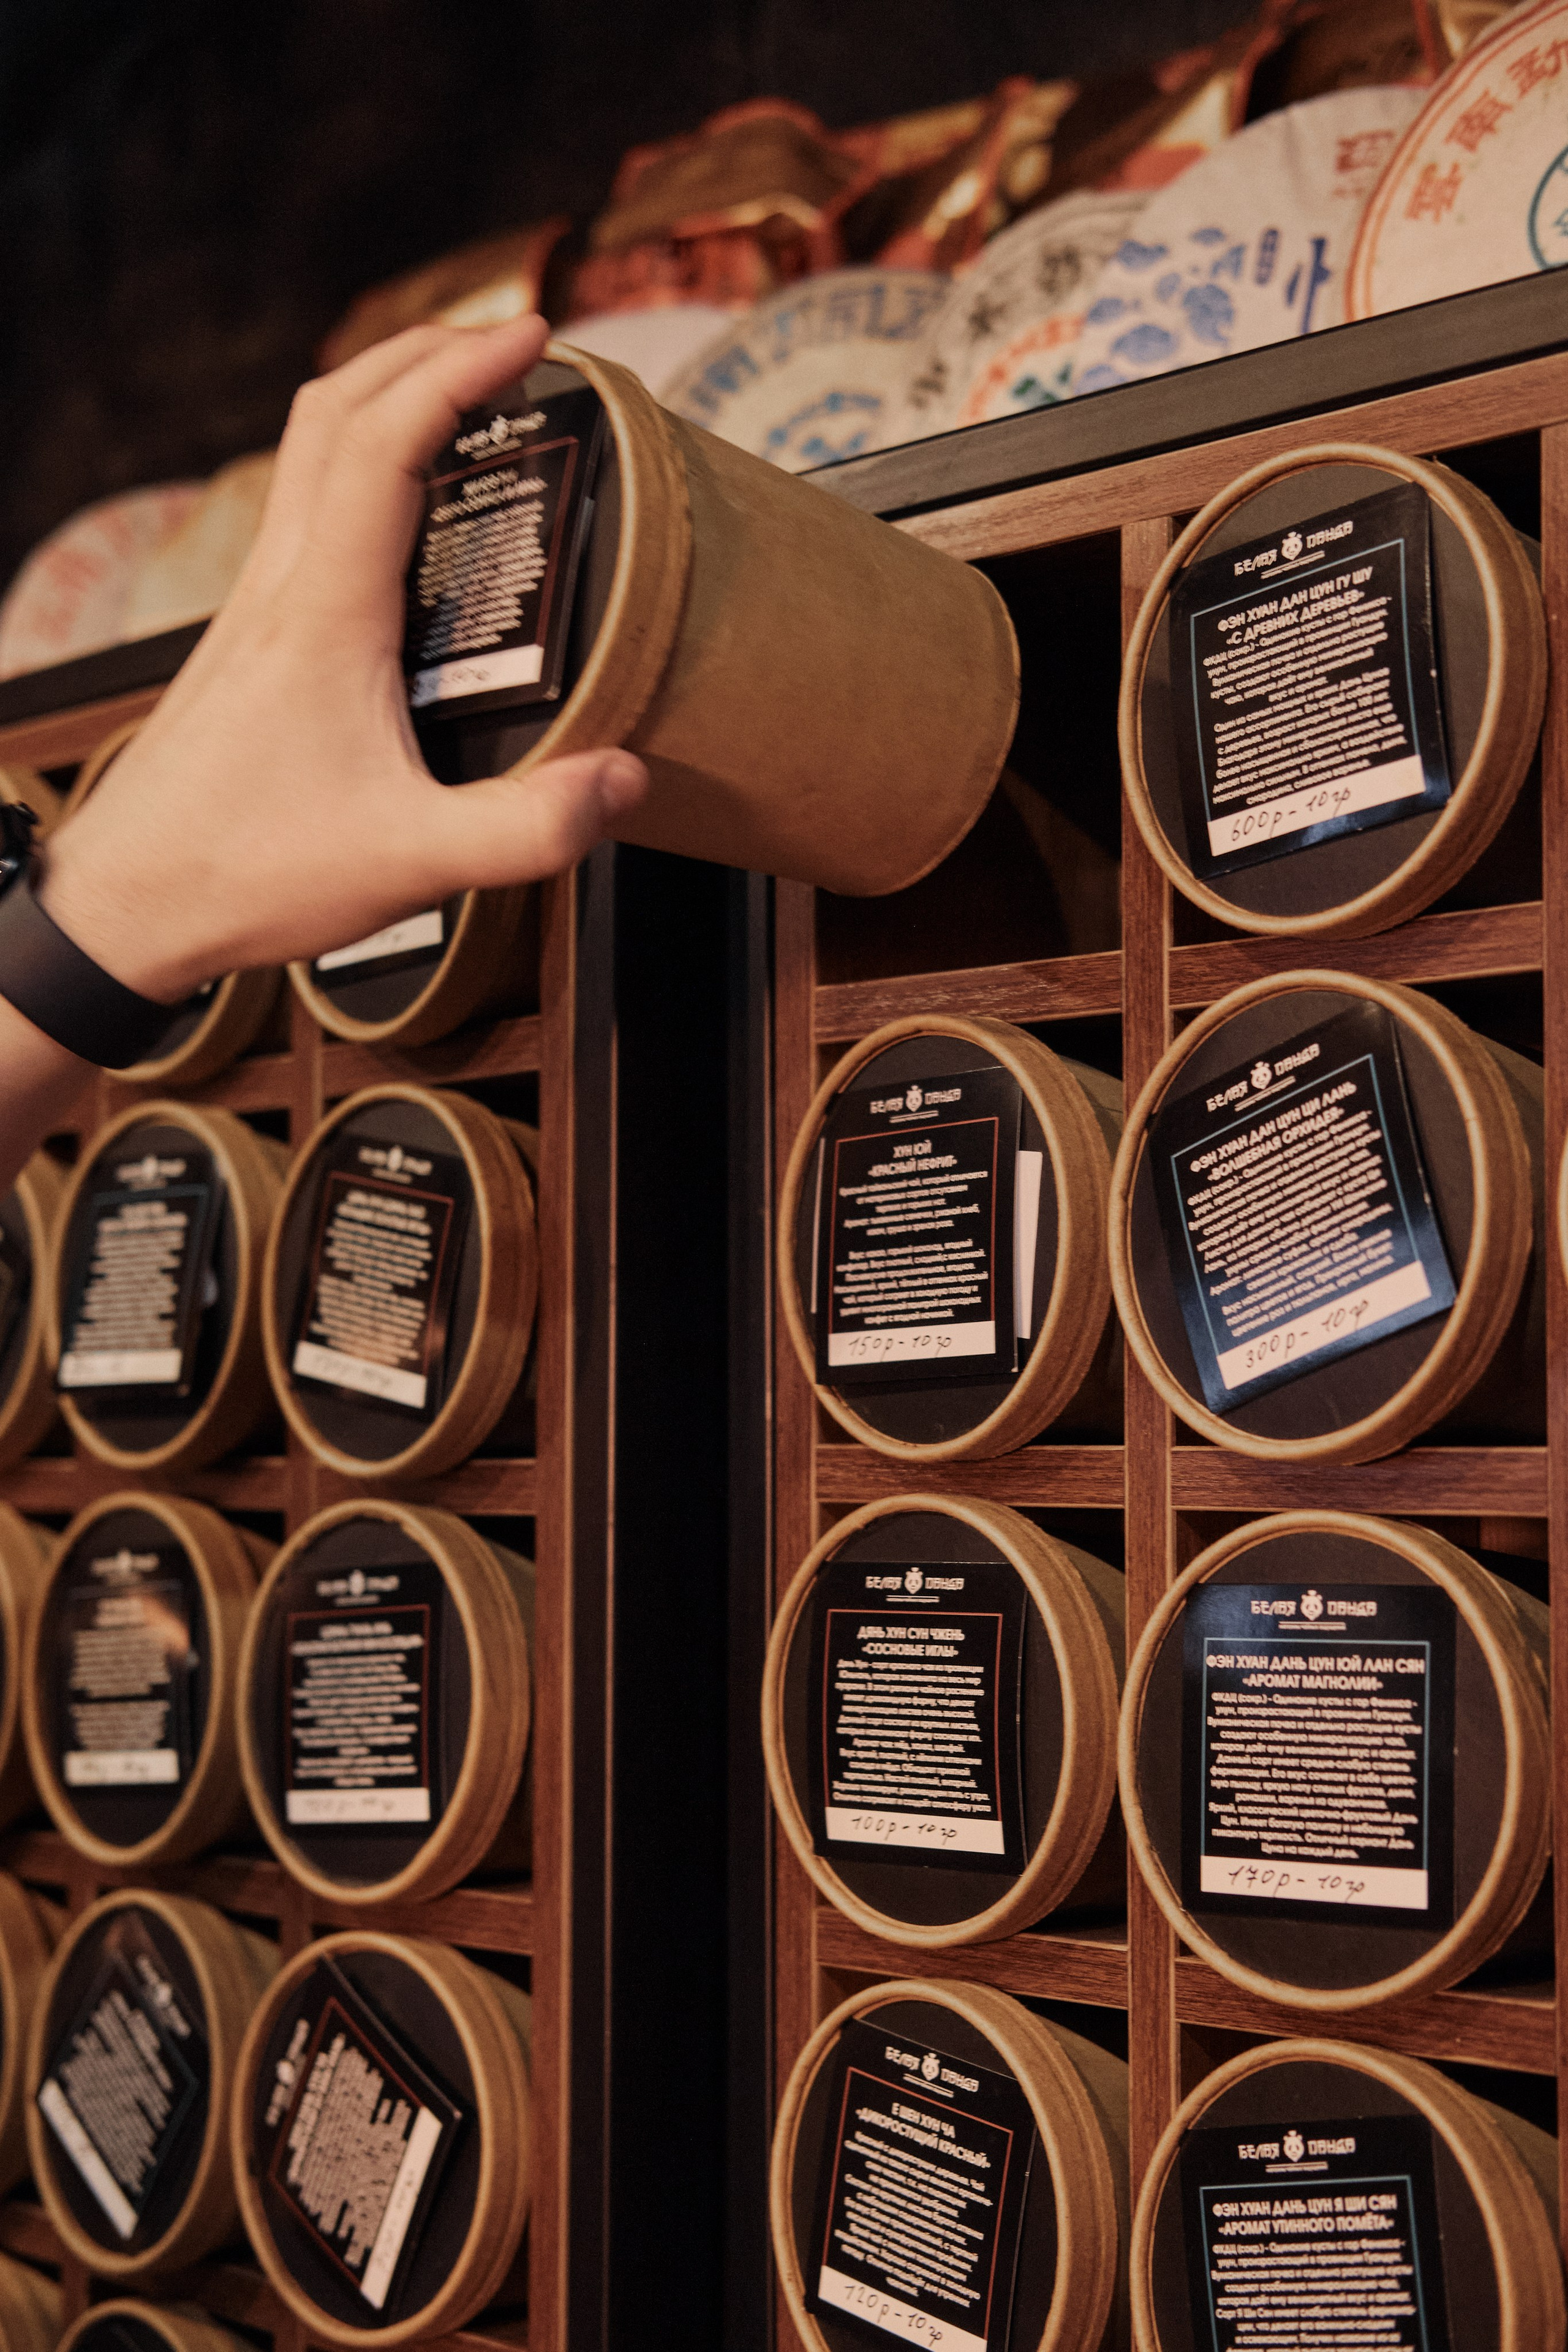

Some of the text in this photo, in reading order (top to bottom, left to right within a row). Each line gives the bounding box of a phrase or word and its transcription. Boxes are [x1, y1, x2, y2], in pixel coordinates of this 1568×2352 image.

[1234, 549, 1278, 576] БЕЛАЯ
[1306, 521, 1353, 548] ПАНДА
[1218, 566, 1373, 631] ФЭН ХУАН ДАН ЦУН ГУ ШУ
[1243, 610, 1299, 643] ДРЕВНИХ
[1206, 1080, 1248, 1112] БЕЛАЯ
[1274, 1044, 1320, 1076] ПАНДА
[870, 1088, 961, 1114] БЕЛАЯ ПАНДА
[1190, 1151, 1218, 1172] ФЭН
[1216, 1135, 1248, 1160] ХУАН
[1249, 1120, 1276, 1145] ДАН
[1276, 1107, 1302, 1129] ЦУН
[1301, 1098, 1321, 1117] ЦИ
[1322, 1082, 1357, 1107] ЛАНЬ
[893, 1139, 932, 1158] ХУН ЮЙ
[865, 1576, 965, 1590] БЕЛАЯ ПАНДА
[1250, 1600, 1377, 1616] БЕЛАЯ ПАНДА
[857, 1626, 965, 1641] ДЯНЬ ХУН СУН ЧЖЕНЬ
[1207, 1654, 1425, 1673] ФЭН ХУАН ДАНЬ ЦУН ЮЙ ЛАН СЯН
[886, 2046, 921, 2070] БЕЛАЯ
[941, 2068, 979, 2092] ПАНДА
[891, 2103, 956, 2138] Е ШЕН ХУН ЧА
[1238, 2138, 1355, 2159] БЕЛАЯ ПАНДА
[1213, 2195, 1397, 2217] ФЭН ХУАН ДАНЬ ЦУН Я ШИ СЯН
[1271, 2217, 1335, 2234] УТИННОГО
